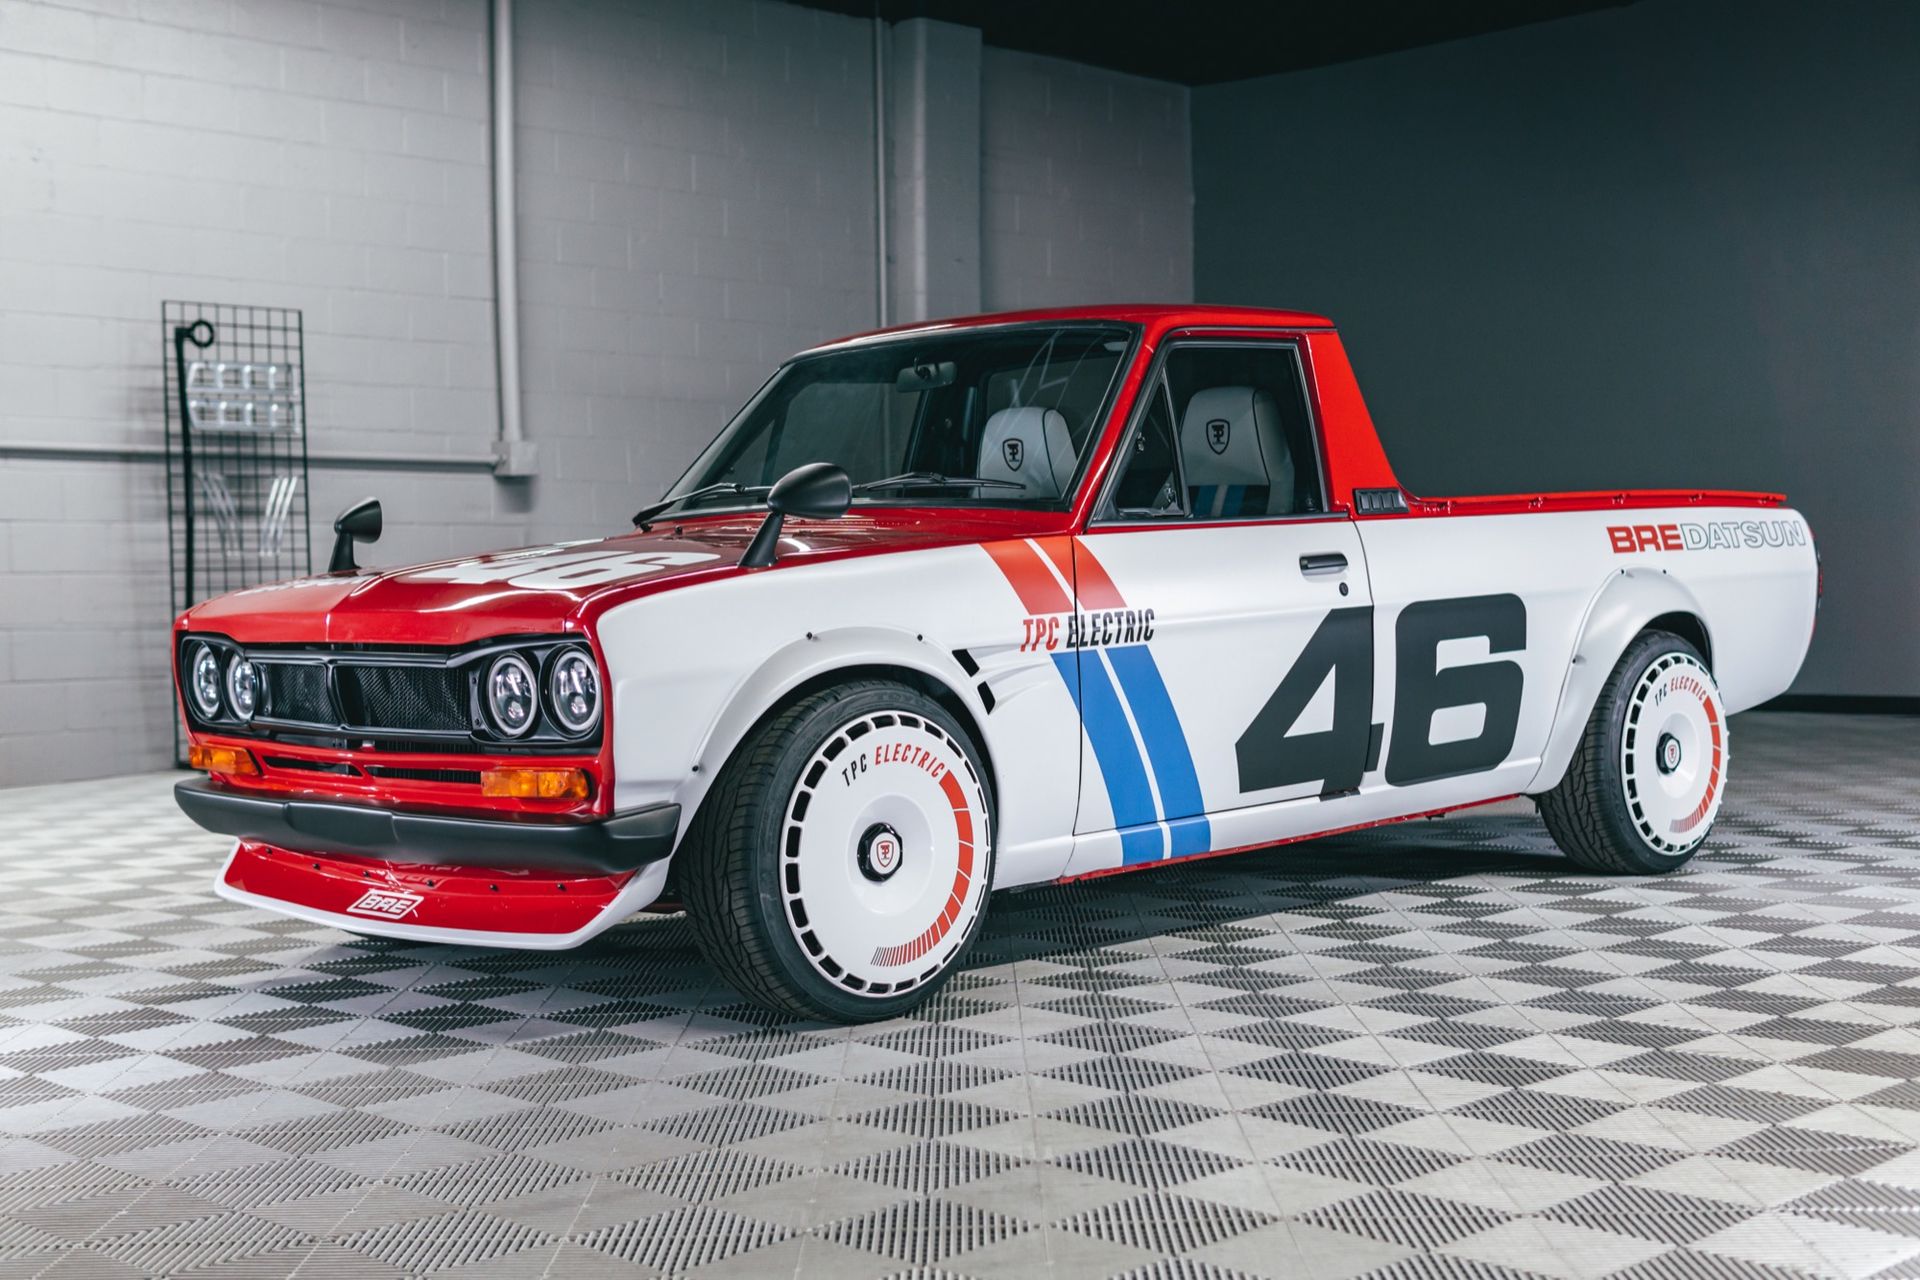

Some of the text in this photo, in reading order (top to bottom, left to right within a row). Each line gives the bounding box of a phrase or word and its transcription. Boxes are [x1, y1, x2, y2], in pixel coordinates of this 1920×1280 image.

[1020, 608, 1155, 652] TPC ELECTRIC
[1235, 593, 1527, 802] 46
[1655, 676, 1706, 706] TPC ELECTRIC
[841, 743, 945, 787] TPC ELECTRIC
[358, 896, 412, 913] BRE
